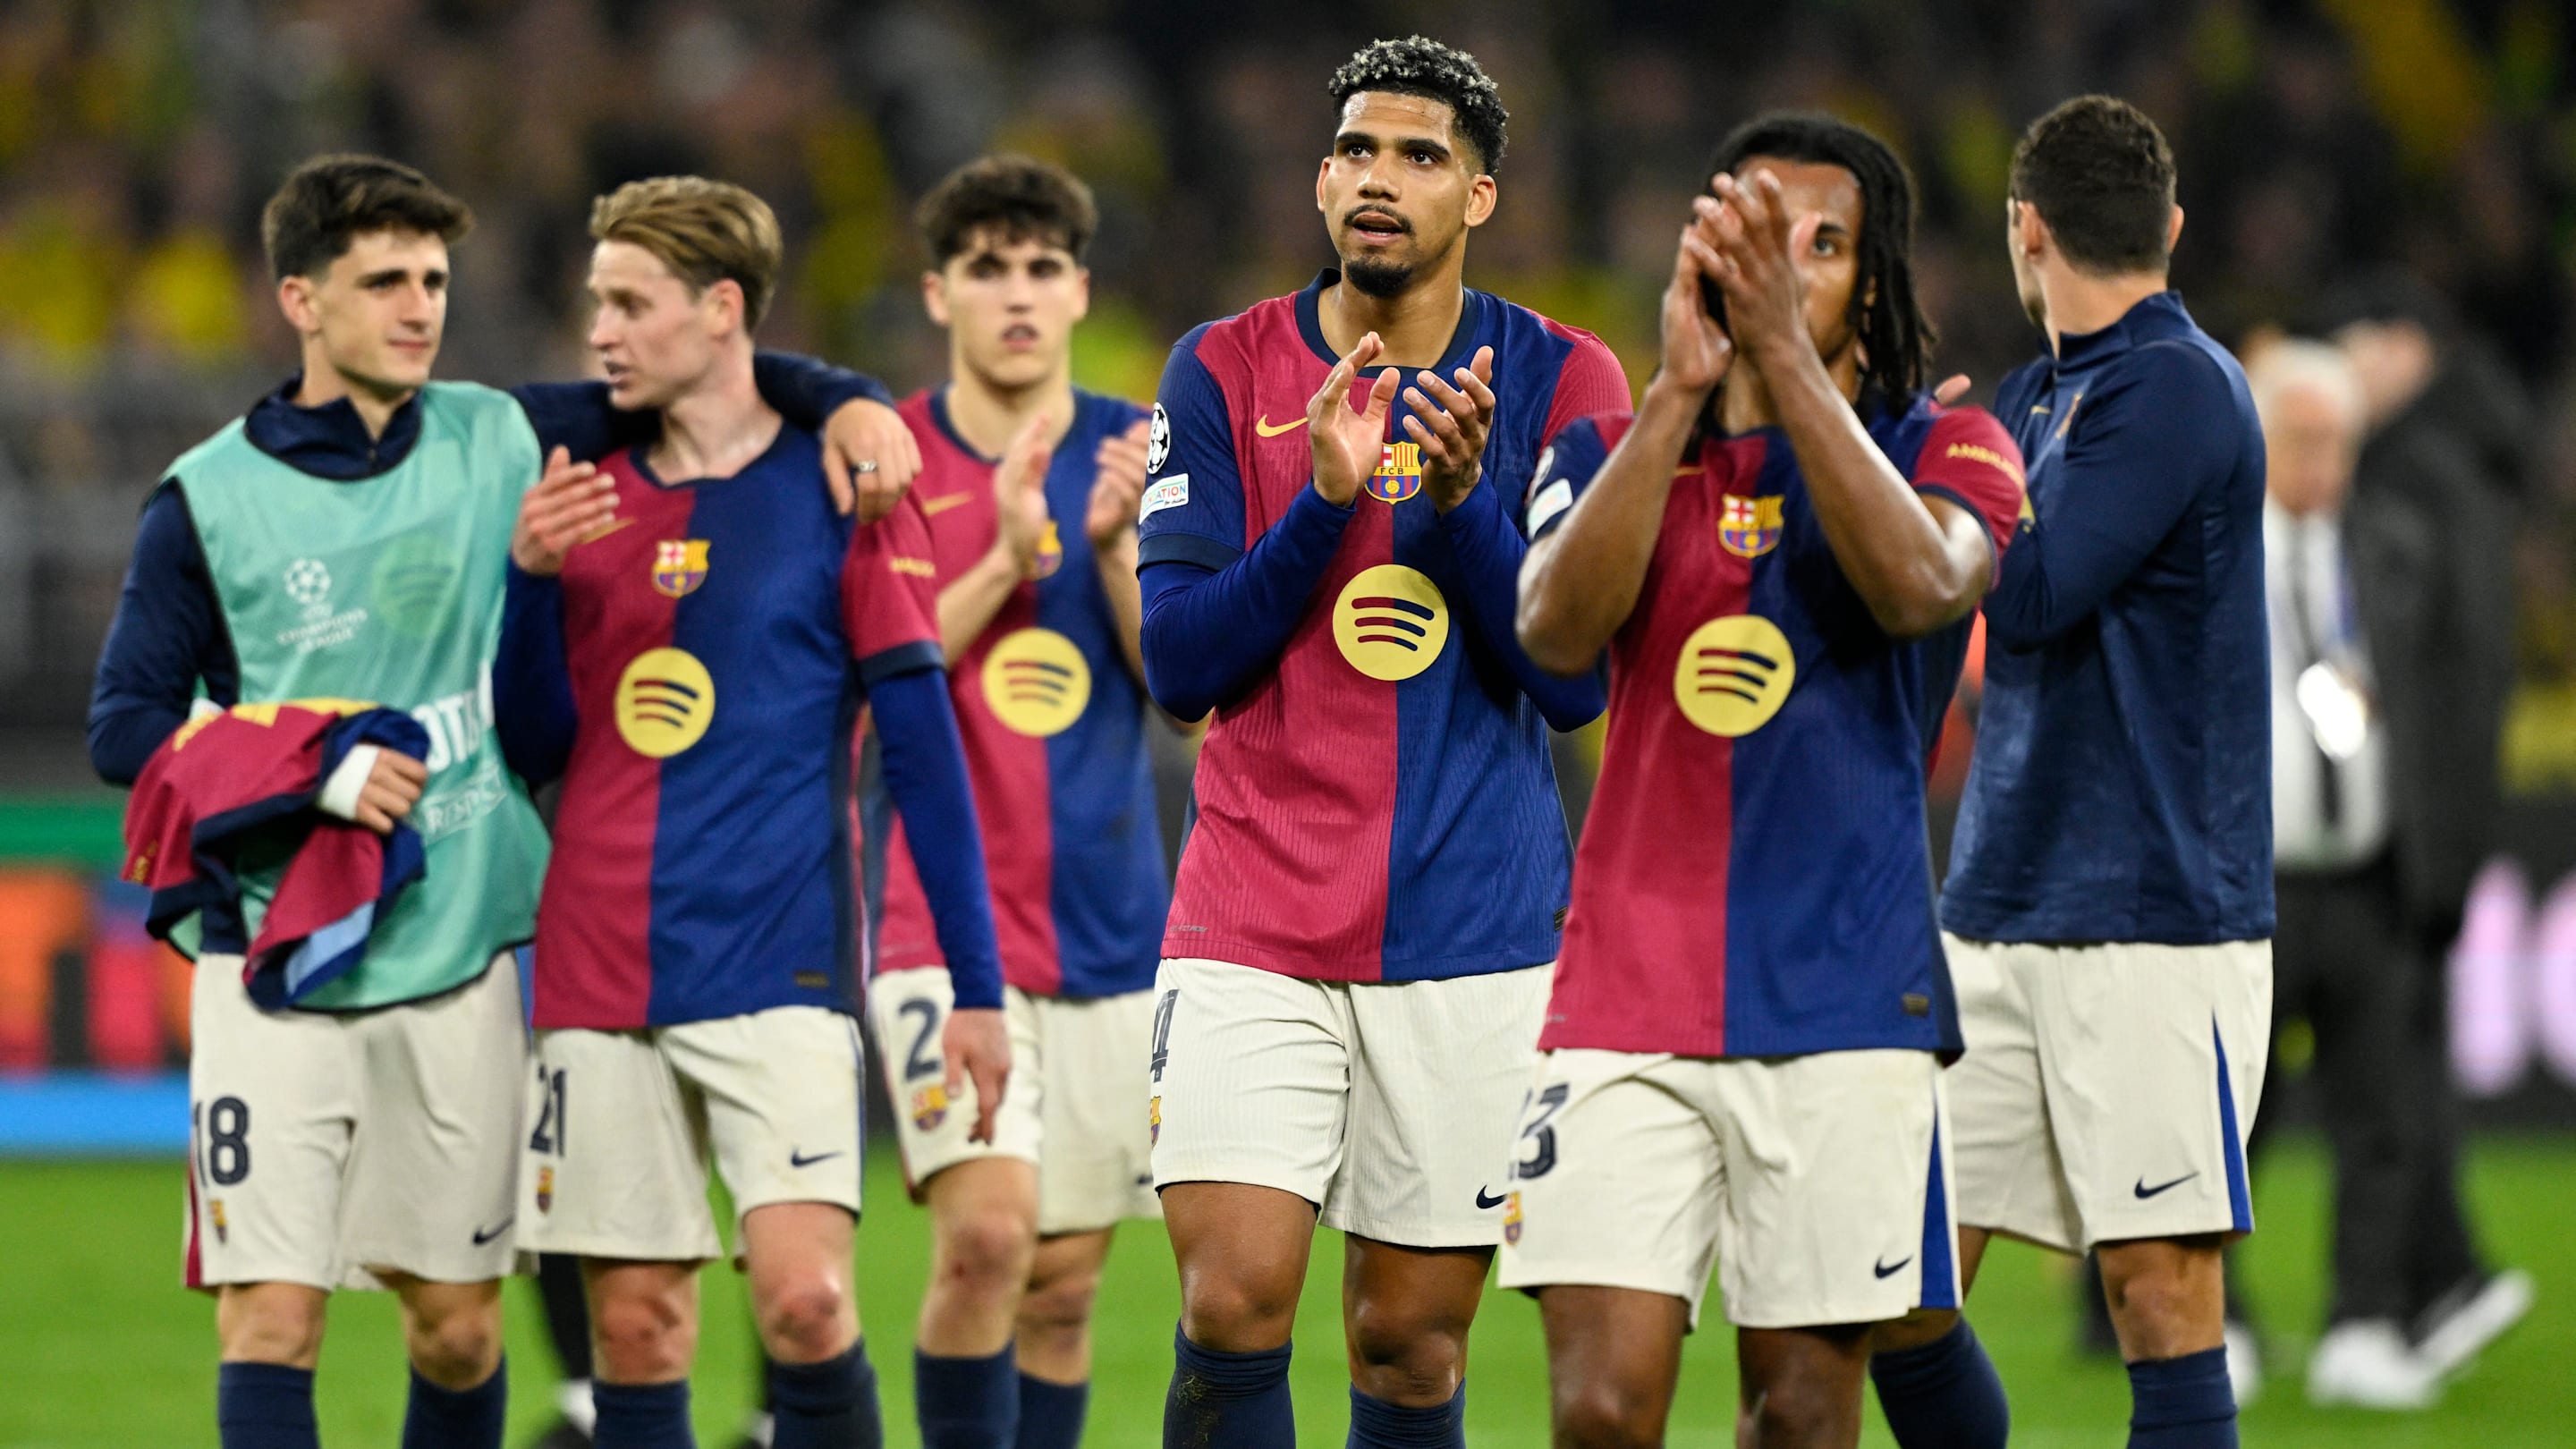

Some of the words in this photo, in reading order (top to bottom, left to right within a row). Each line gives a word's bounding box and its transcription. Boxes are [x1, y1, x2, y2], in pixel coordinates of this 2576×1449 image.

[1380, 467, 1404, 475] FCB
[898, 996, 942, 1080] 2
[530, 1064, 566, 1157] 21
